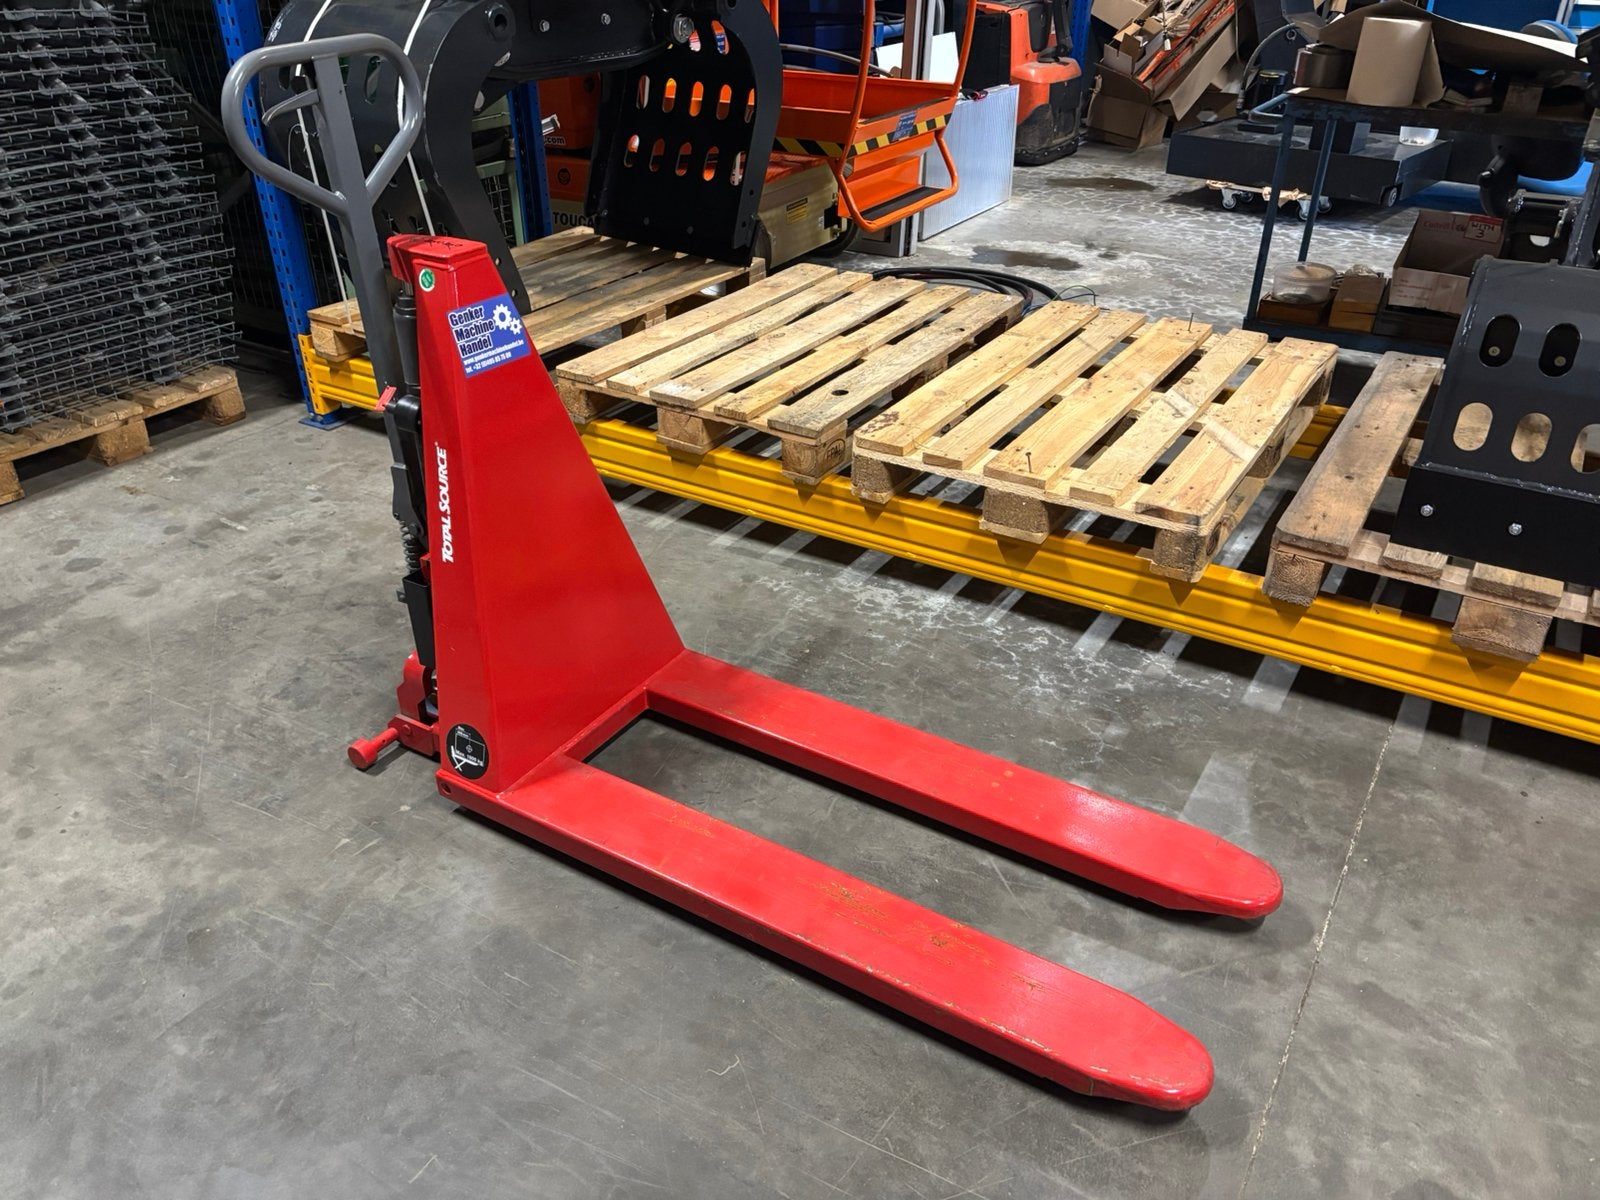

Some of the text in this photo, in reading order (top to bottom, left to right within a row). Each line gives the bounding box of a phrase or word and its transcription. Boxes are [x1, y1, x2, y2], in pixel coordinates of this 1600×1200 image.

[552, 211, 594, 227] TOUCA
[449, 306, 484, 327] Genker
[454, 320, 495, 342] Machine
[459, 335, 492, 357] Handel
